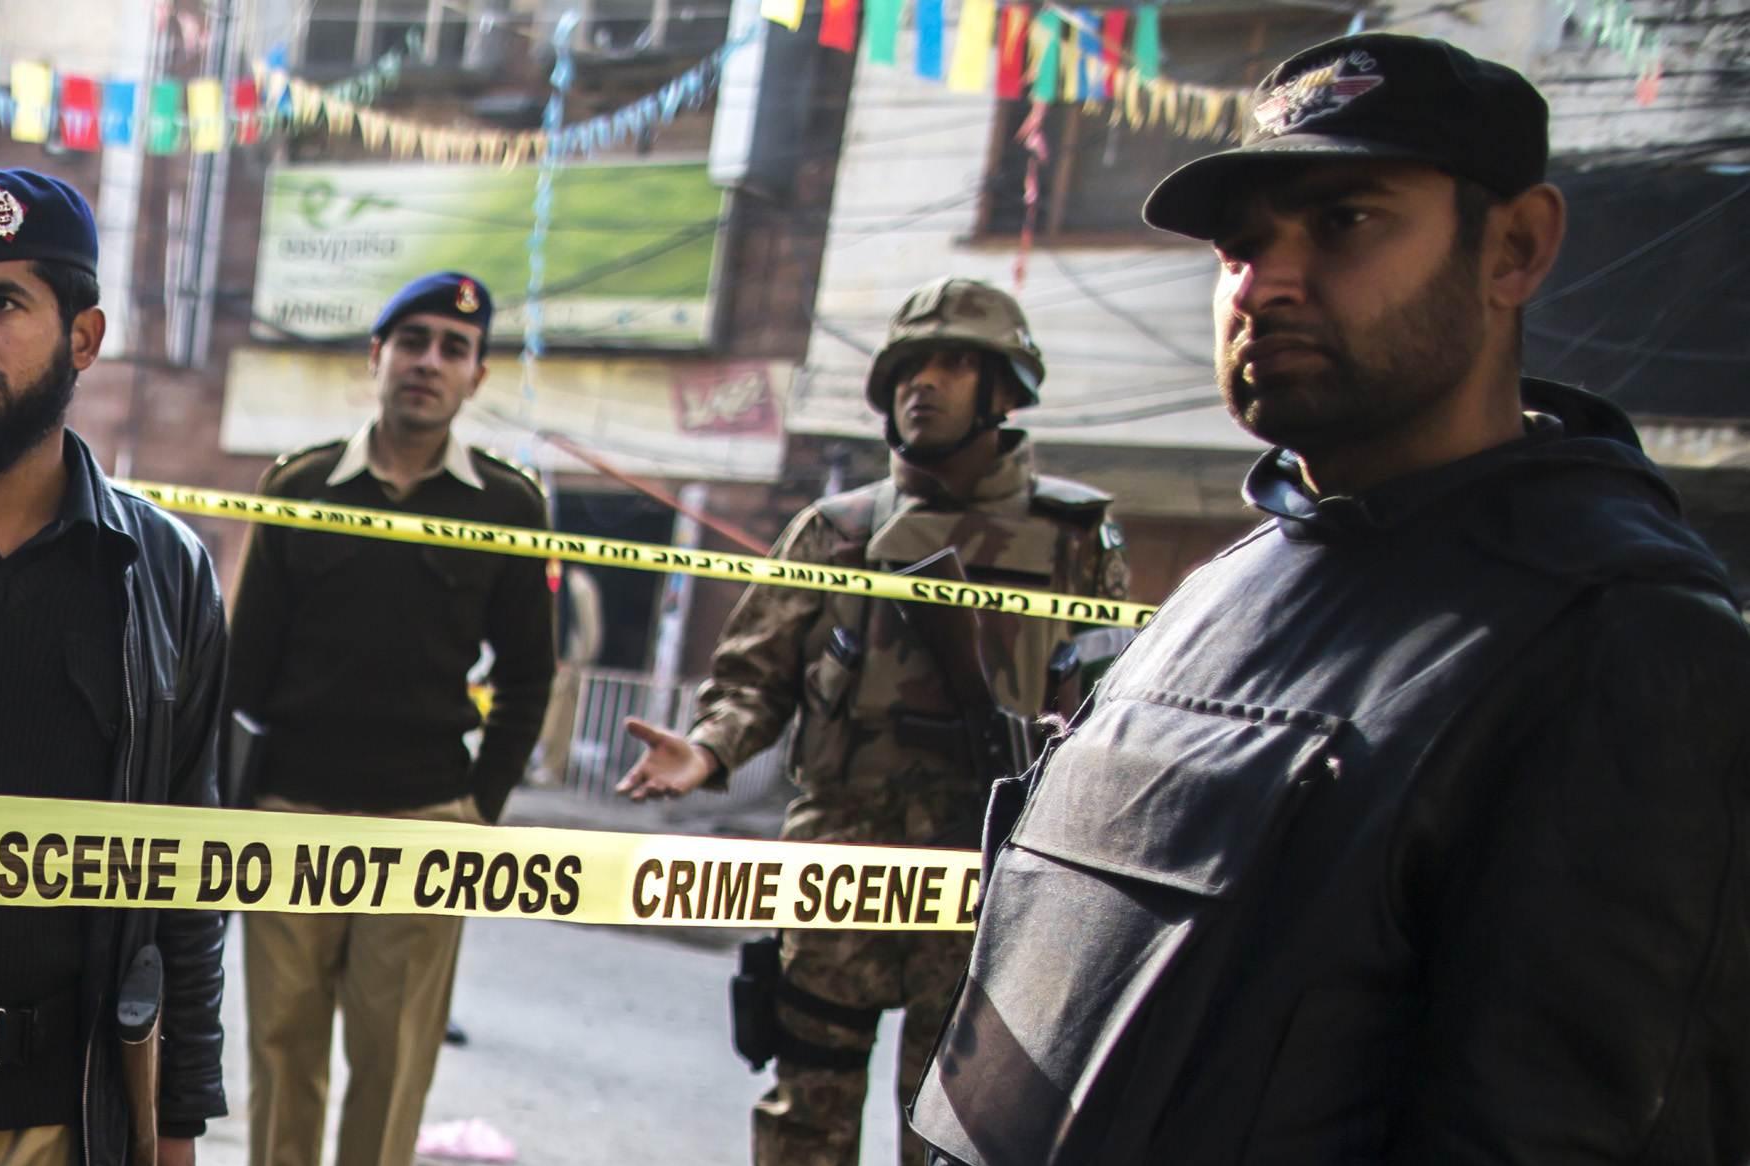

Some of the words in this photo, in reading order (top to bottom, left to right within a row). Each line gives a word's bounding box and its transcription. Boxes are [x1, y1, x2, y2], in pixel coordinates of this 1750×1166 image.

[196, 841, 272, 904] DO
[289, 845, 402, 906] NOT
[414, 848, 582, 915] CROSS
[633, 858, 783, 921] CRIME
[795, 864, 948, 924] SCENE
